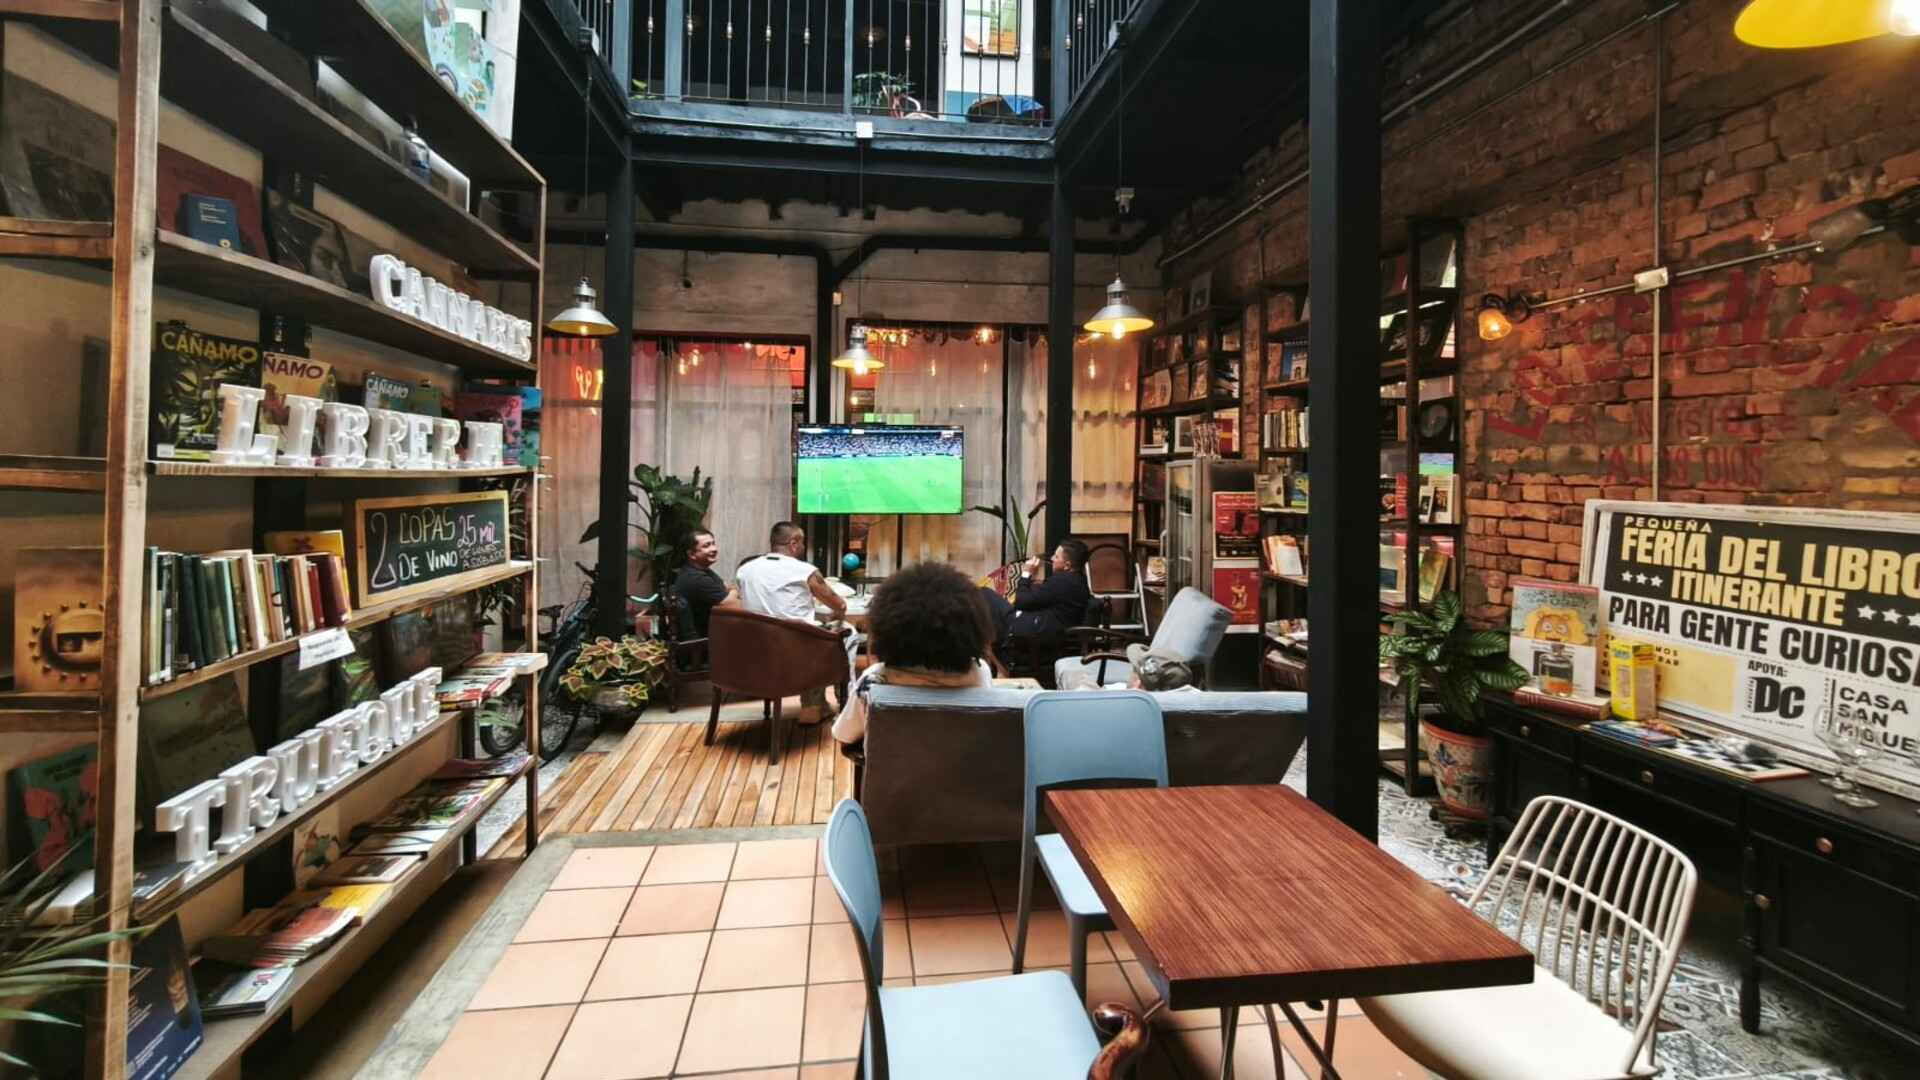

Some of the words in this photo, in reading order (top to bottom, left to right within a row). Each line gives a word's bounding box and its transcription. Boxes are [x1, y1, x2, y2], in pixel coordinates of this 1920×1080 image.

[161, 330, 259, 363] CAÑAMO
[366, 377, 409, 399] CAÑAMO
[1624, 516, 1712, 533] PEQUEÑA
[398, 553, 420, 581] DE
[426, 550, 458, 572] VINO
[1621, 528, 1707, 570] FERIA
[1719, 535, 1787, 580] DEL
[1801, 543, 1920, 599] LIBRO
[1671, 570, 1846, 626] ITINERANTE
[1609, 596, 1670, 634] PARA
[1680, 609, 1769, 654] GENTE
[1748, 660, 1788, 677] APOYA:
[1750, 676, 1805, 719] DC
[1839, 686, 1909, 715] CASA
[1837, 703, 1888, 727] SAN
[156, 667, 443, 883] TRUEQUE
